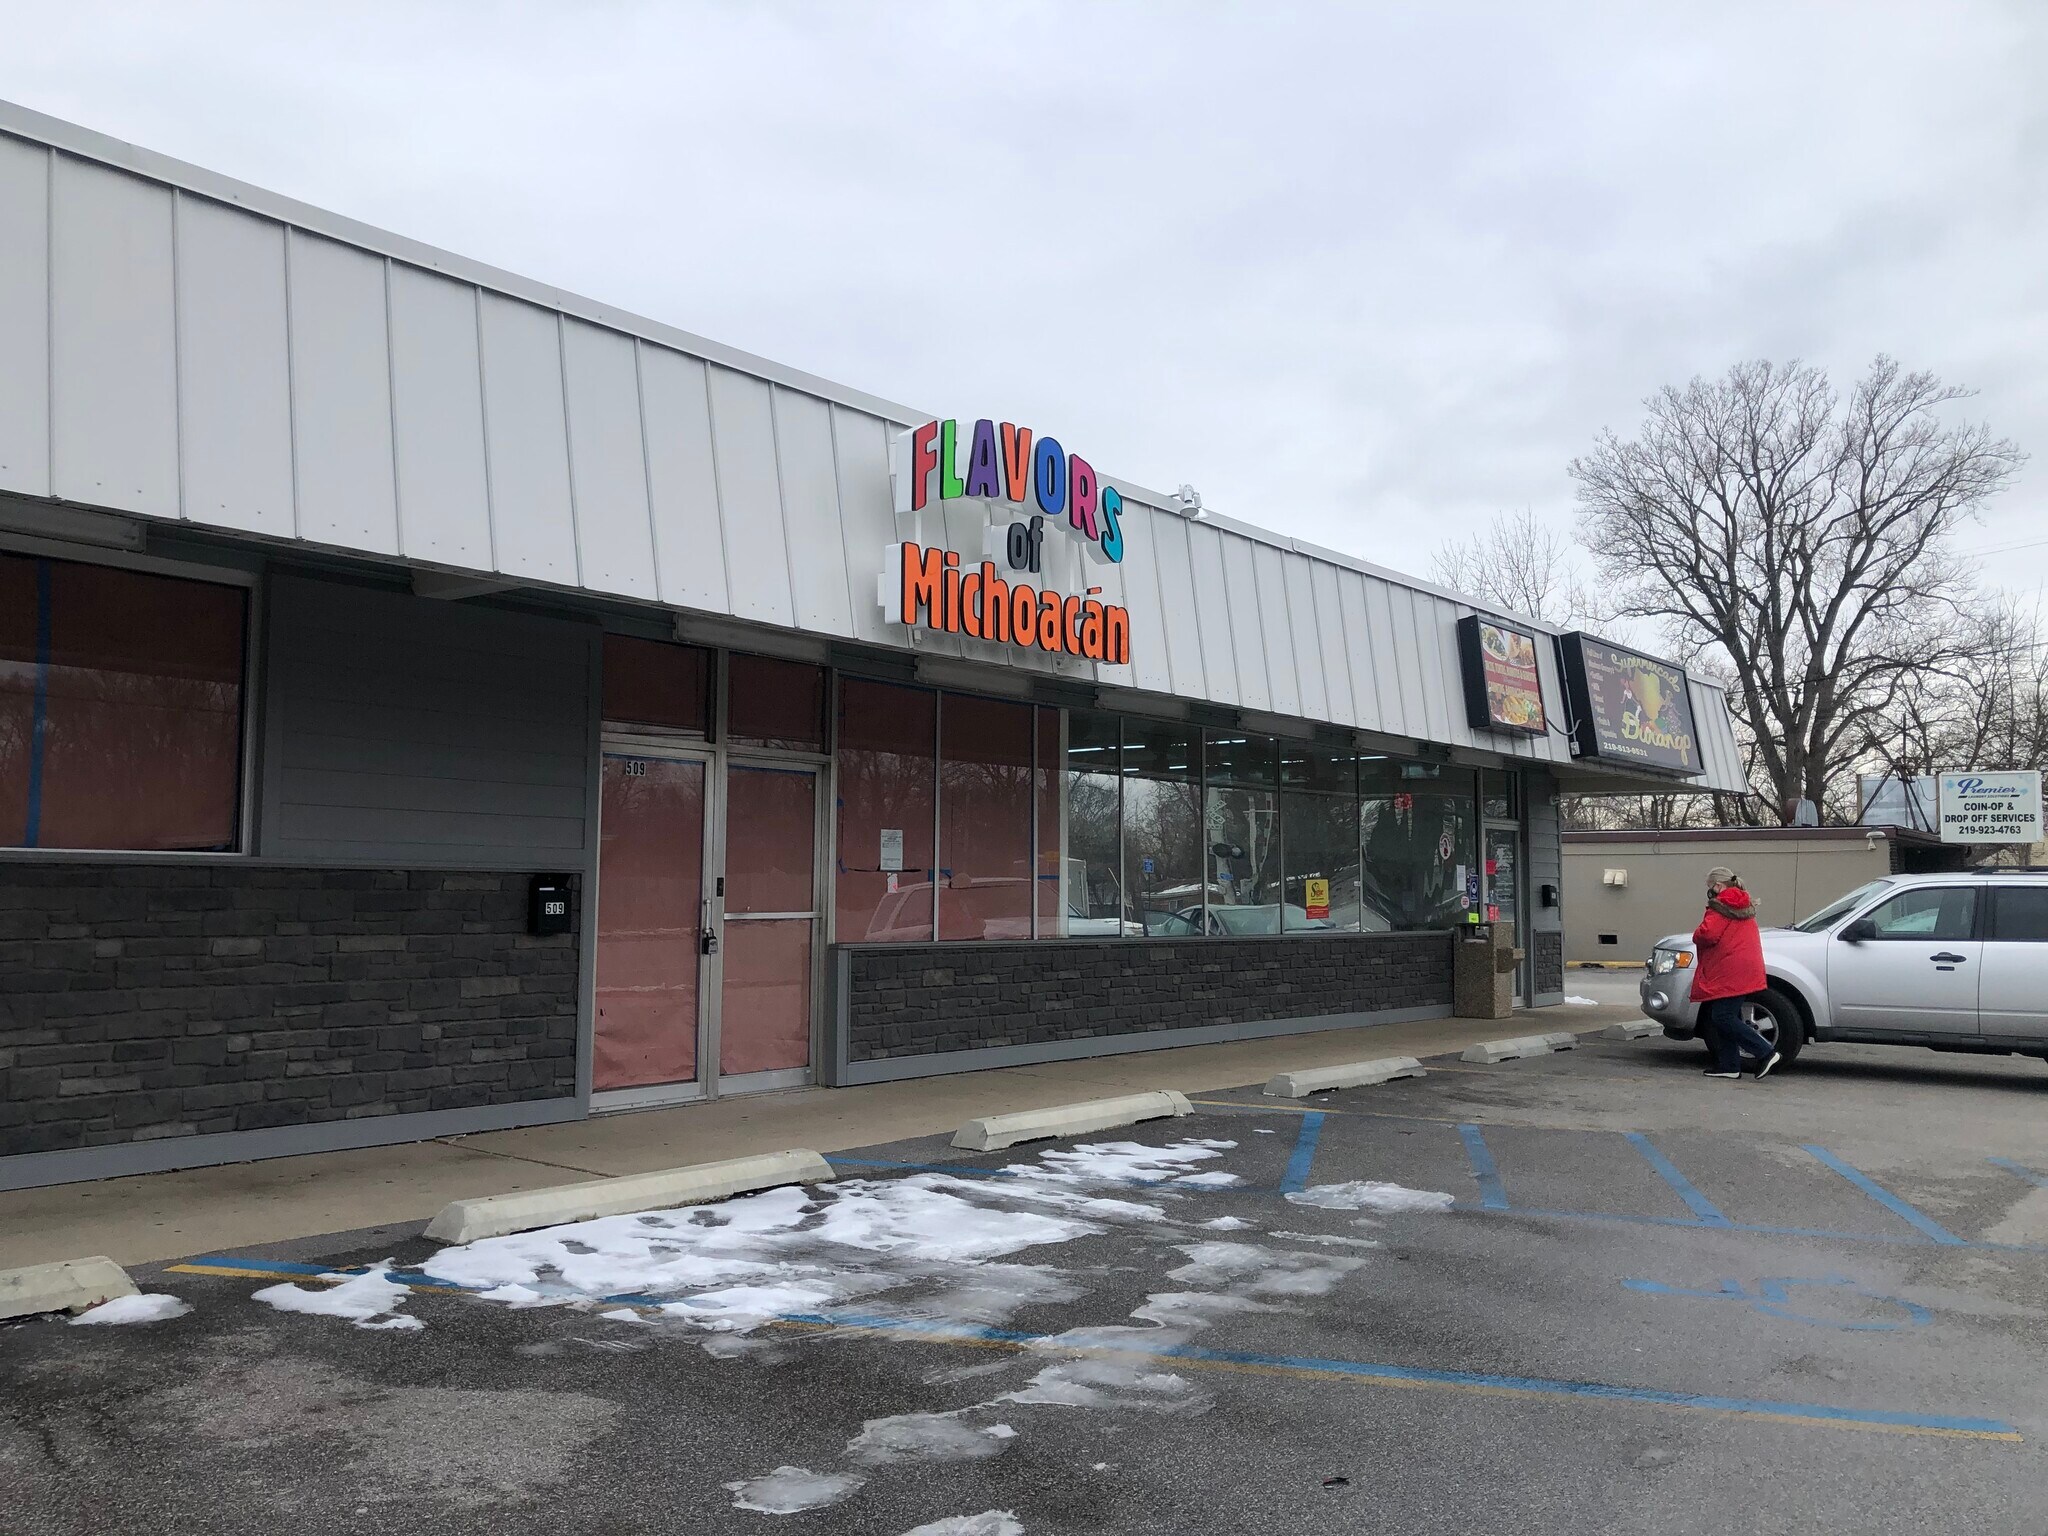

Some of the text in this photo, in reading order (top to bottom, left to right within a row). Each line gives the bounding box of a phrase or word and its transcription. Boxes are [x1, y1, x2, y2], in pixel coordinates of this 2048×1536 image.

[911, 419, 1123, 563] FLAVORS
[1007, 515, 1043, 573] of
[901, 541, 1129, 664] Michoacán
[1621, 711, 1691, 766] Durango
[626, 761, 645, 775] 509
[1957, 777, 2017, 794] Premier
[1963, 801, 2014, 811] COIN-OP &
[1944, 813, 2036, 823] DROP OFF SERVICES
[1958, 825, 2022, 834] 219-923-4763
[546, 903, 564, 914] 509
